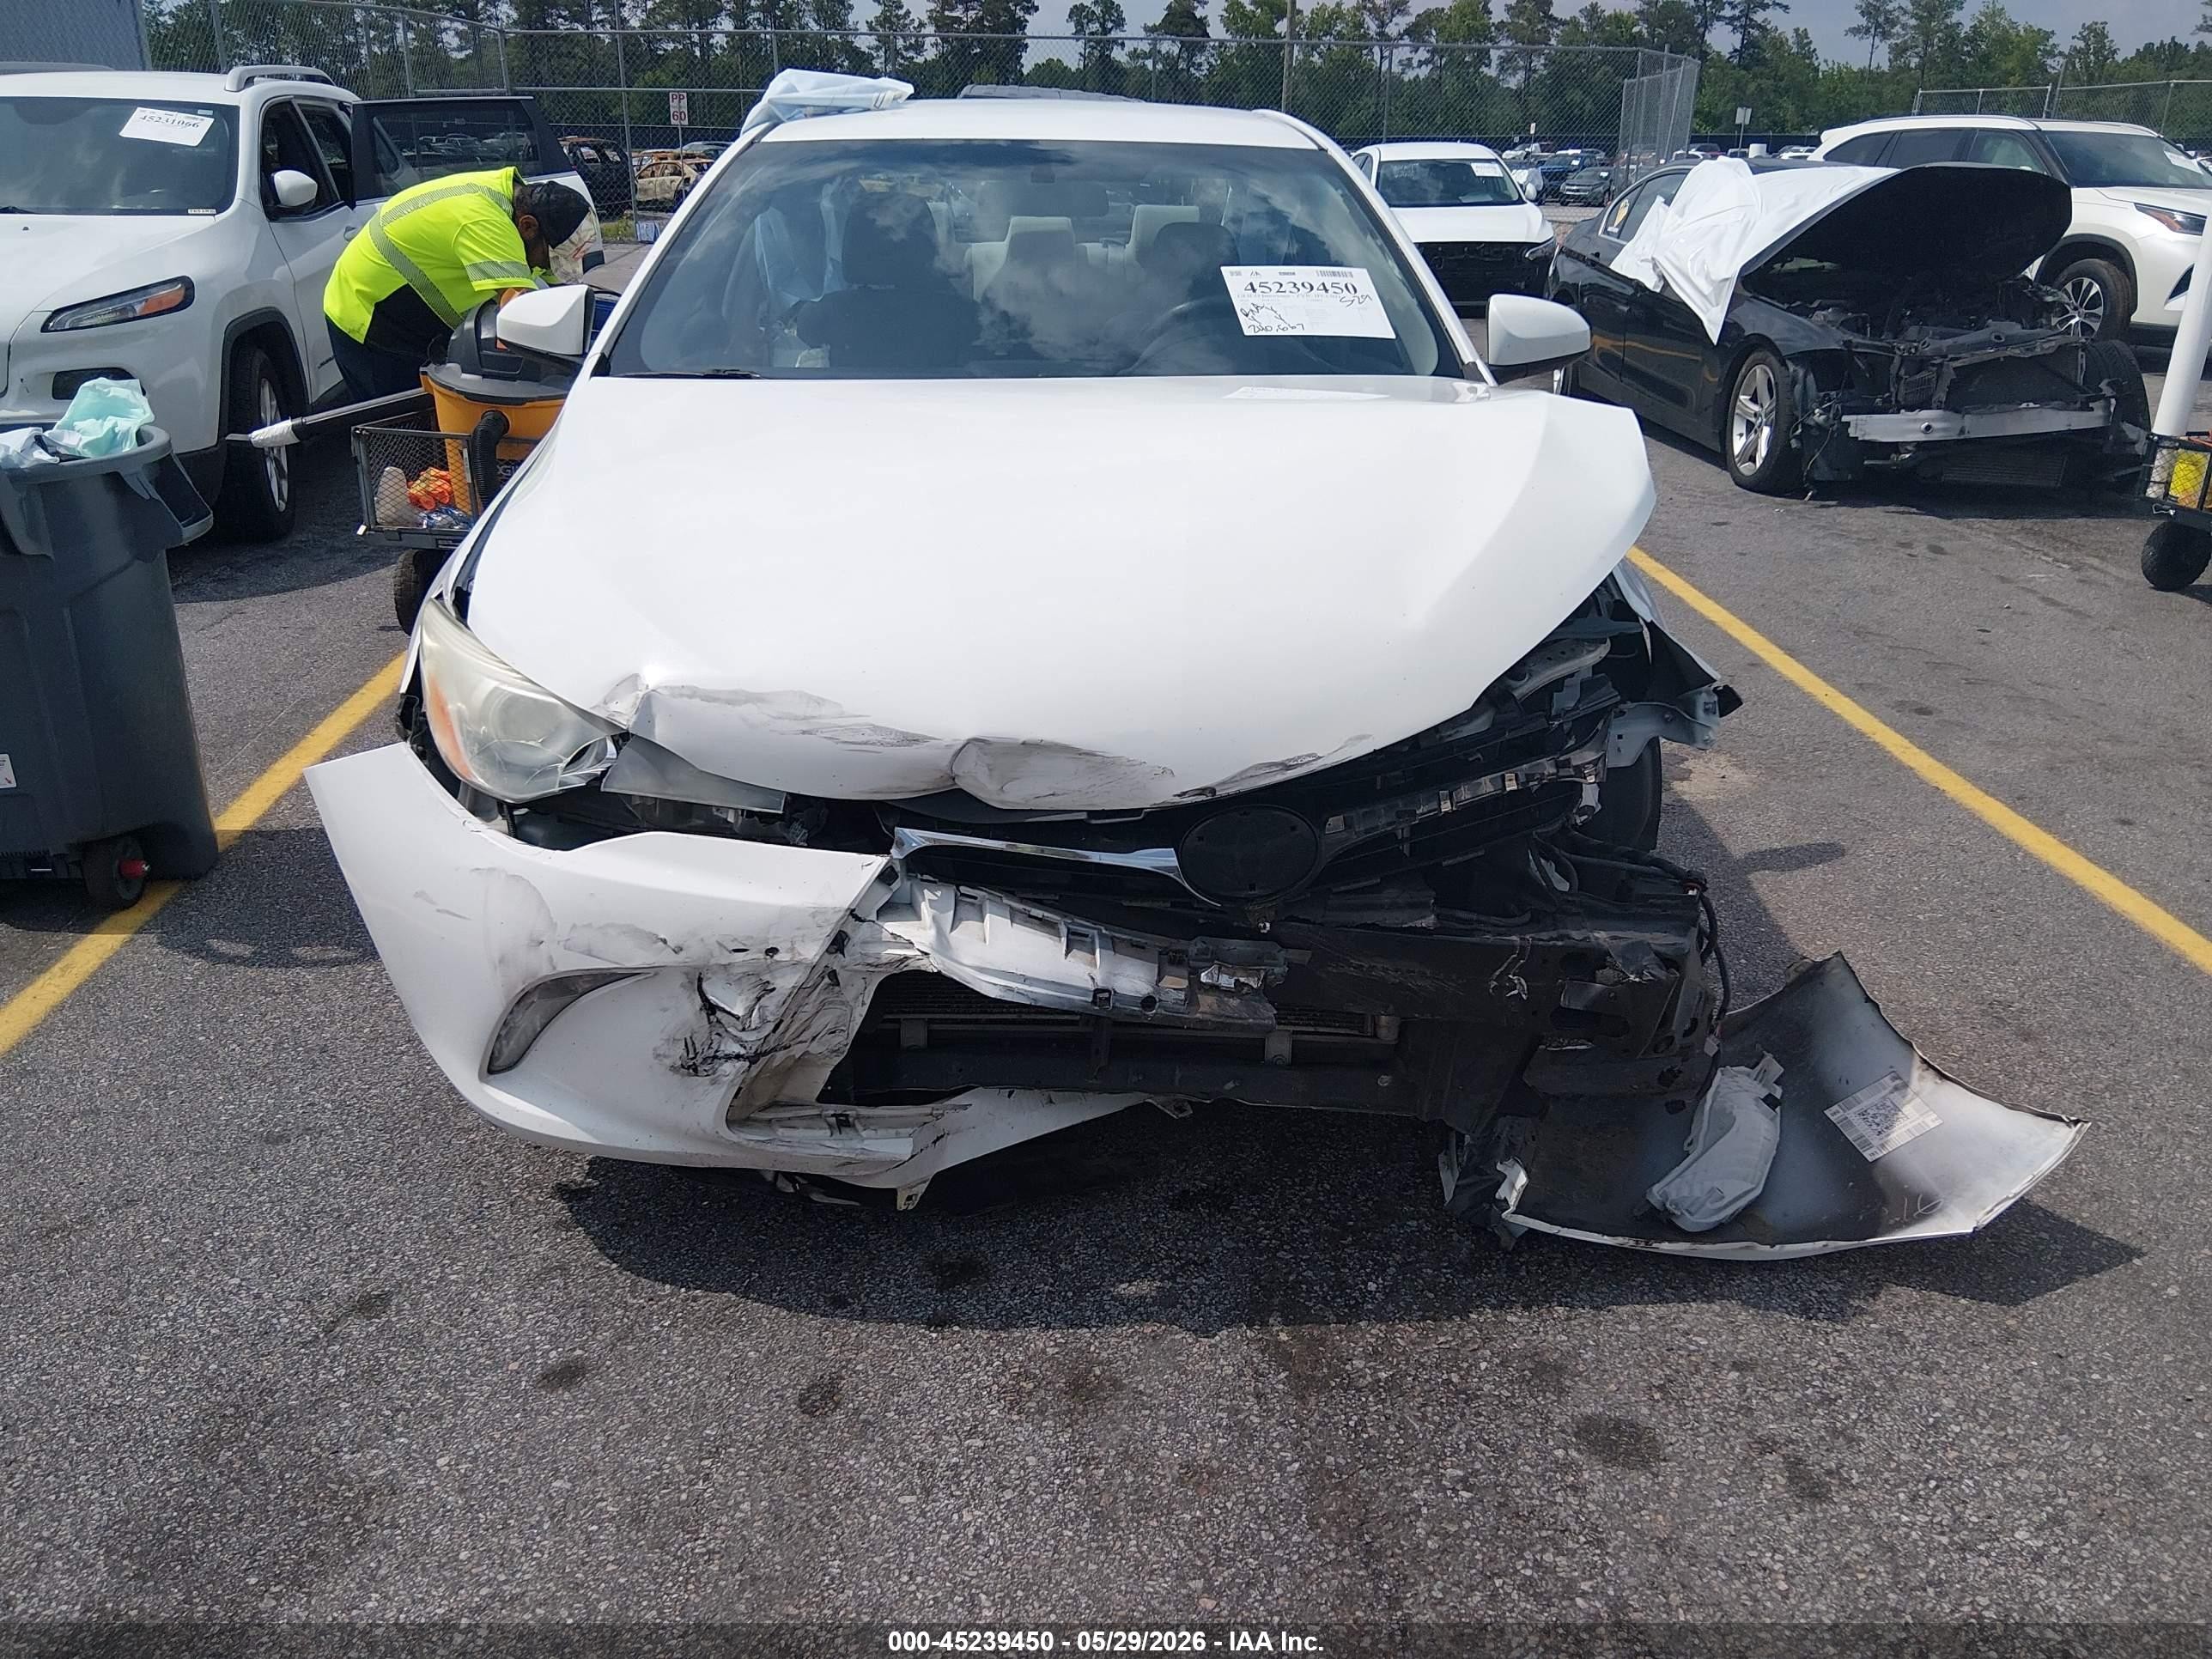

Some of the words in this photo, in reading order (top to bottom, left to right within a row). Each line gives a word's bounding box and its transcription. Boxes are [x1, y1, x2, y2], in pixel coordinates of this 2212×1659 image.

[672, 94, 685, 103] PP
[672, 111, 687, 122] 60
[1244, 281, 1358, 295] 45239450
